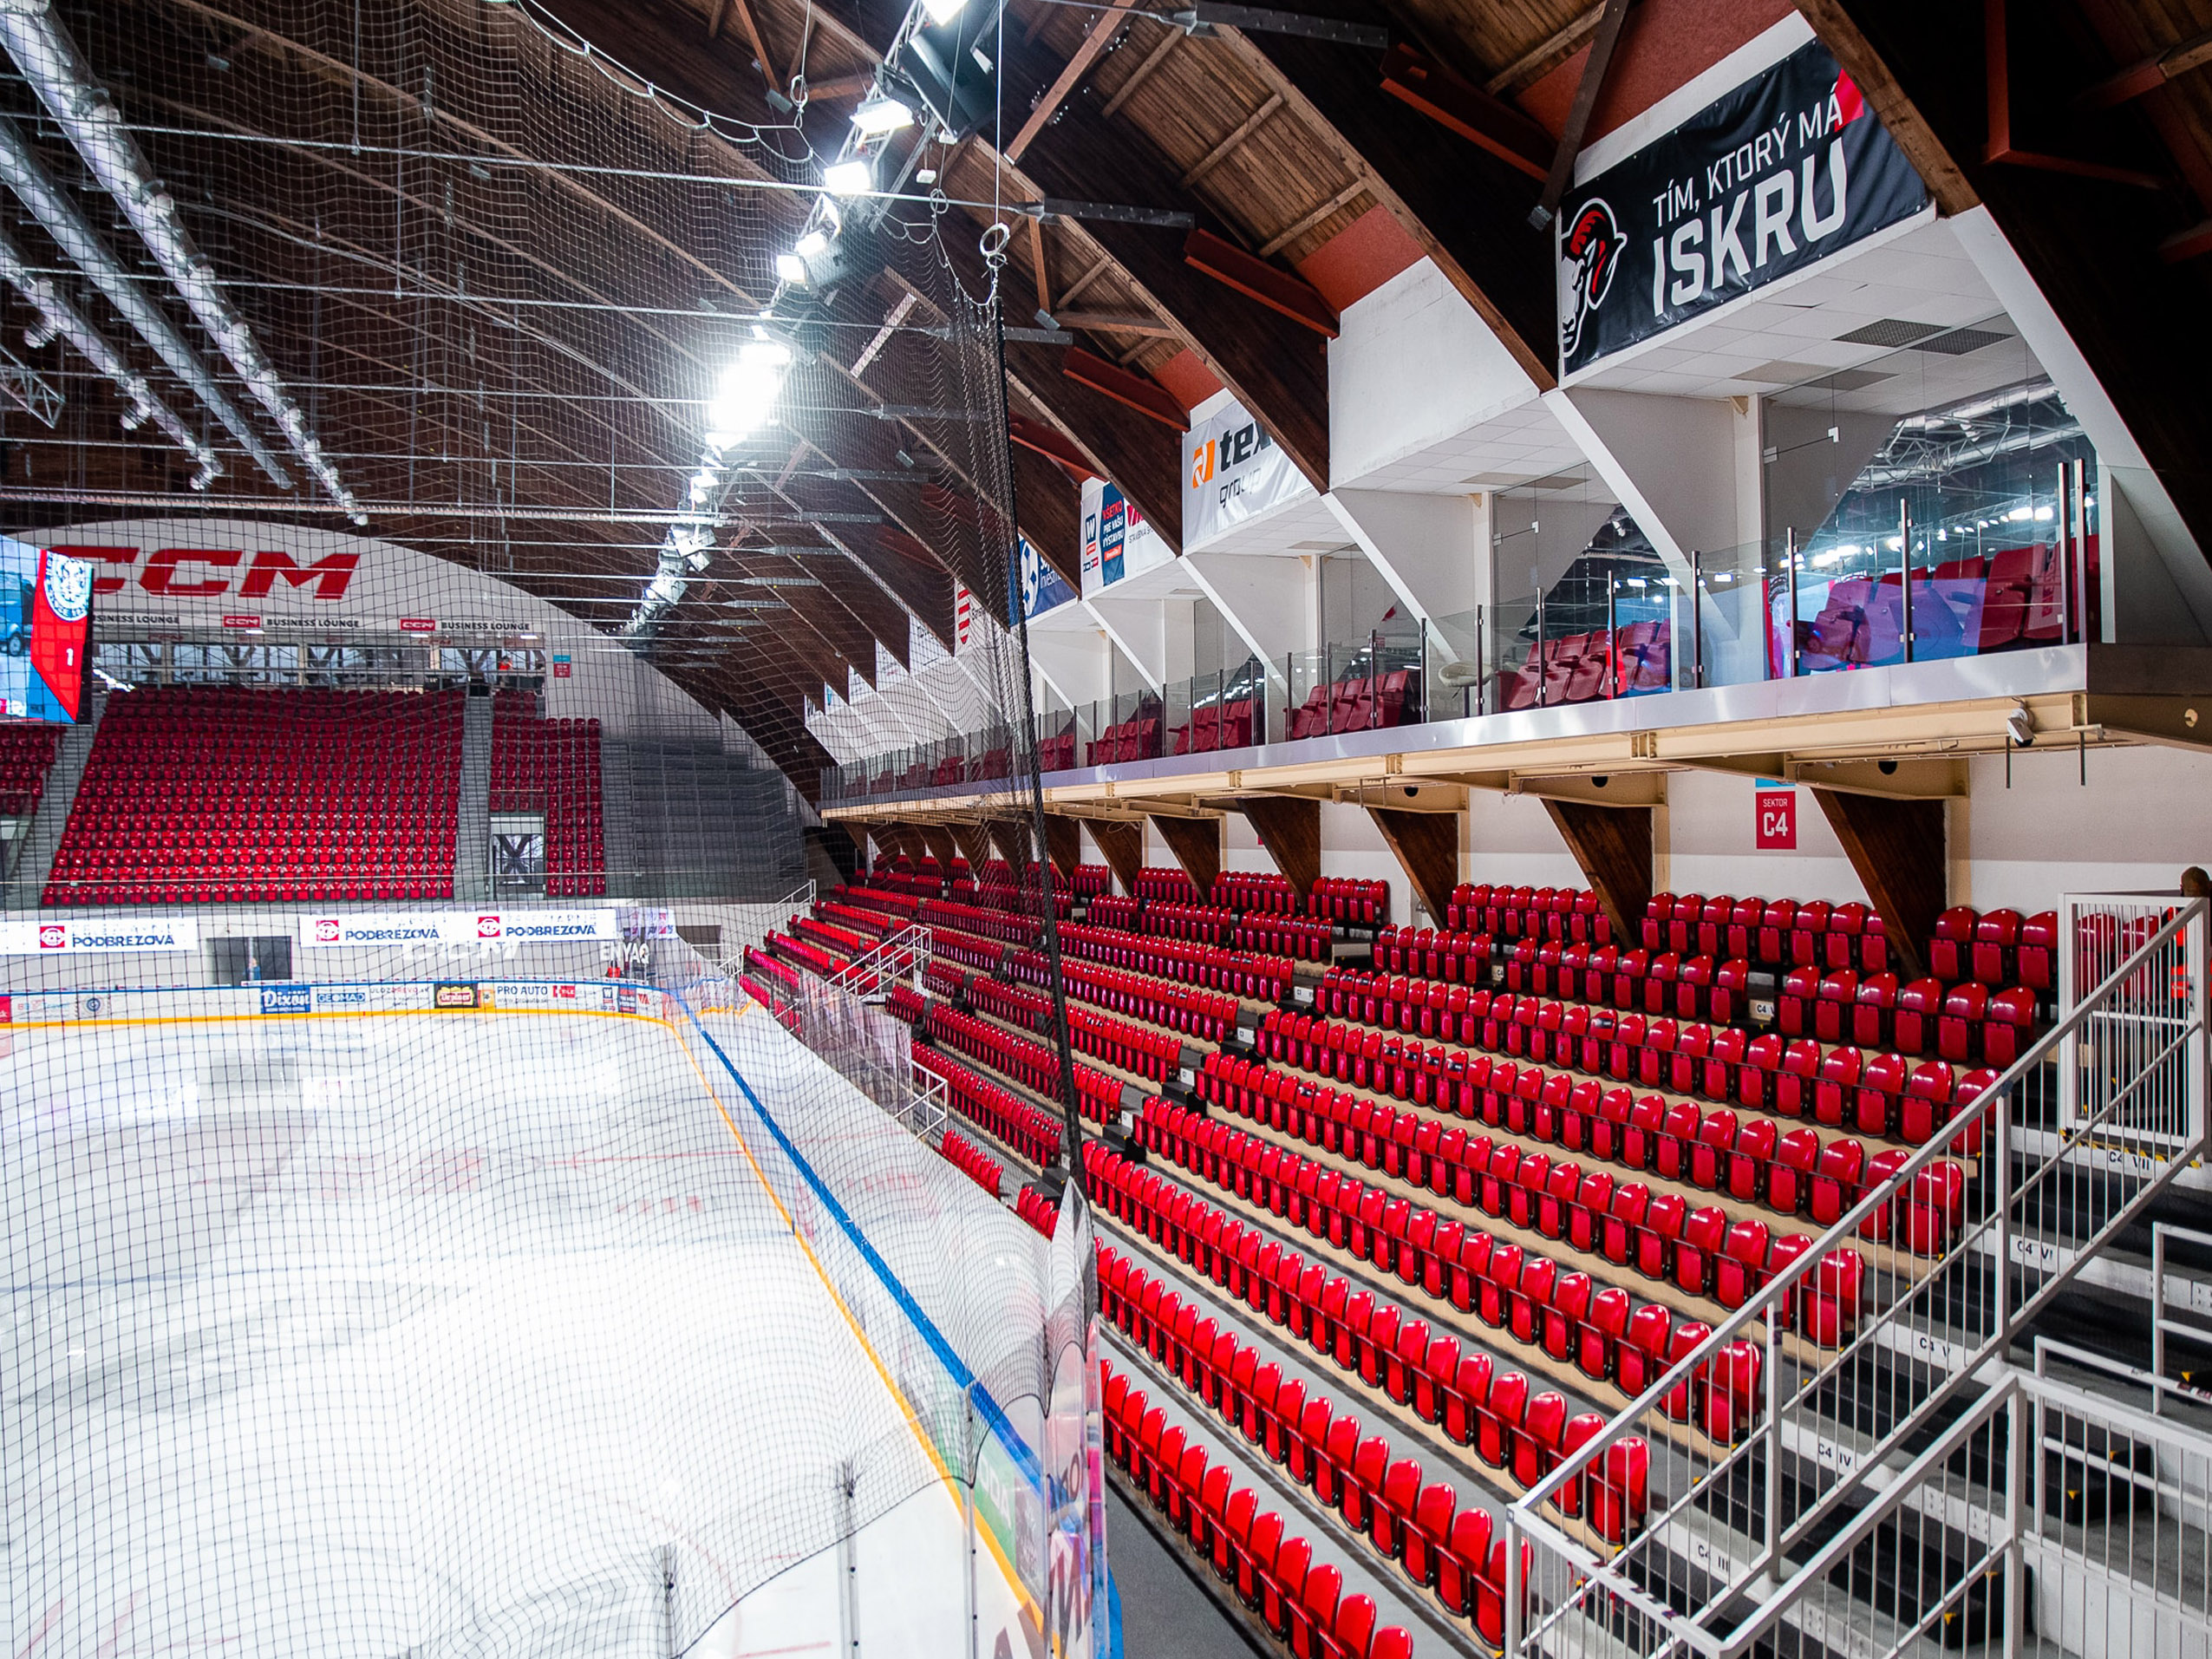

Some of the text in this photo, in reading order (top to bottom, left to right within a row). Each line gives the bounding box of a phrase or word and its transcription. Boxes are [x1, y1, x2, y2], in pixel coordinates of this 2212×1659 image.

[1653, 82, 1843, 228] TÍM, KTORÝ MÁ
[1653, 137, 1848, 317] ISKRU
[1219, 467, 1261, 509] group
[92, 613, 179, 624] SINESS LOUNGE
[266, 617, 360, 629] BUSINESS LOUNGE
[1763, 797, 1788, 808] SEKTOR
[1763, 811, 1788, 838] C4
[497, 985, 548, 996] PRO AUTO
[1757, 1004, 1766, 1013] C4
[2109, 1150, 2124, 1165] C4
[2017, 1240, 2033, 1257] C4
[1919, 1336, 1935, 1351] C4
[1817, 1441, 1852, 1467] C4 IV
